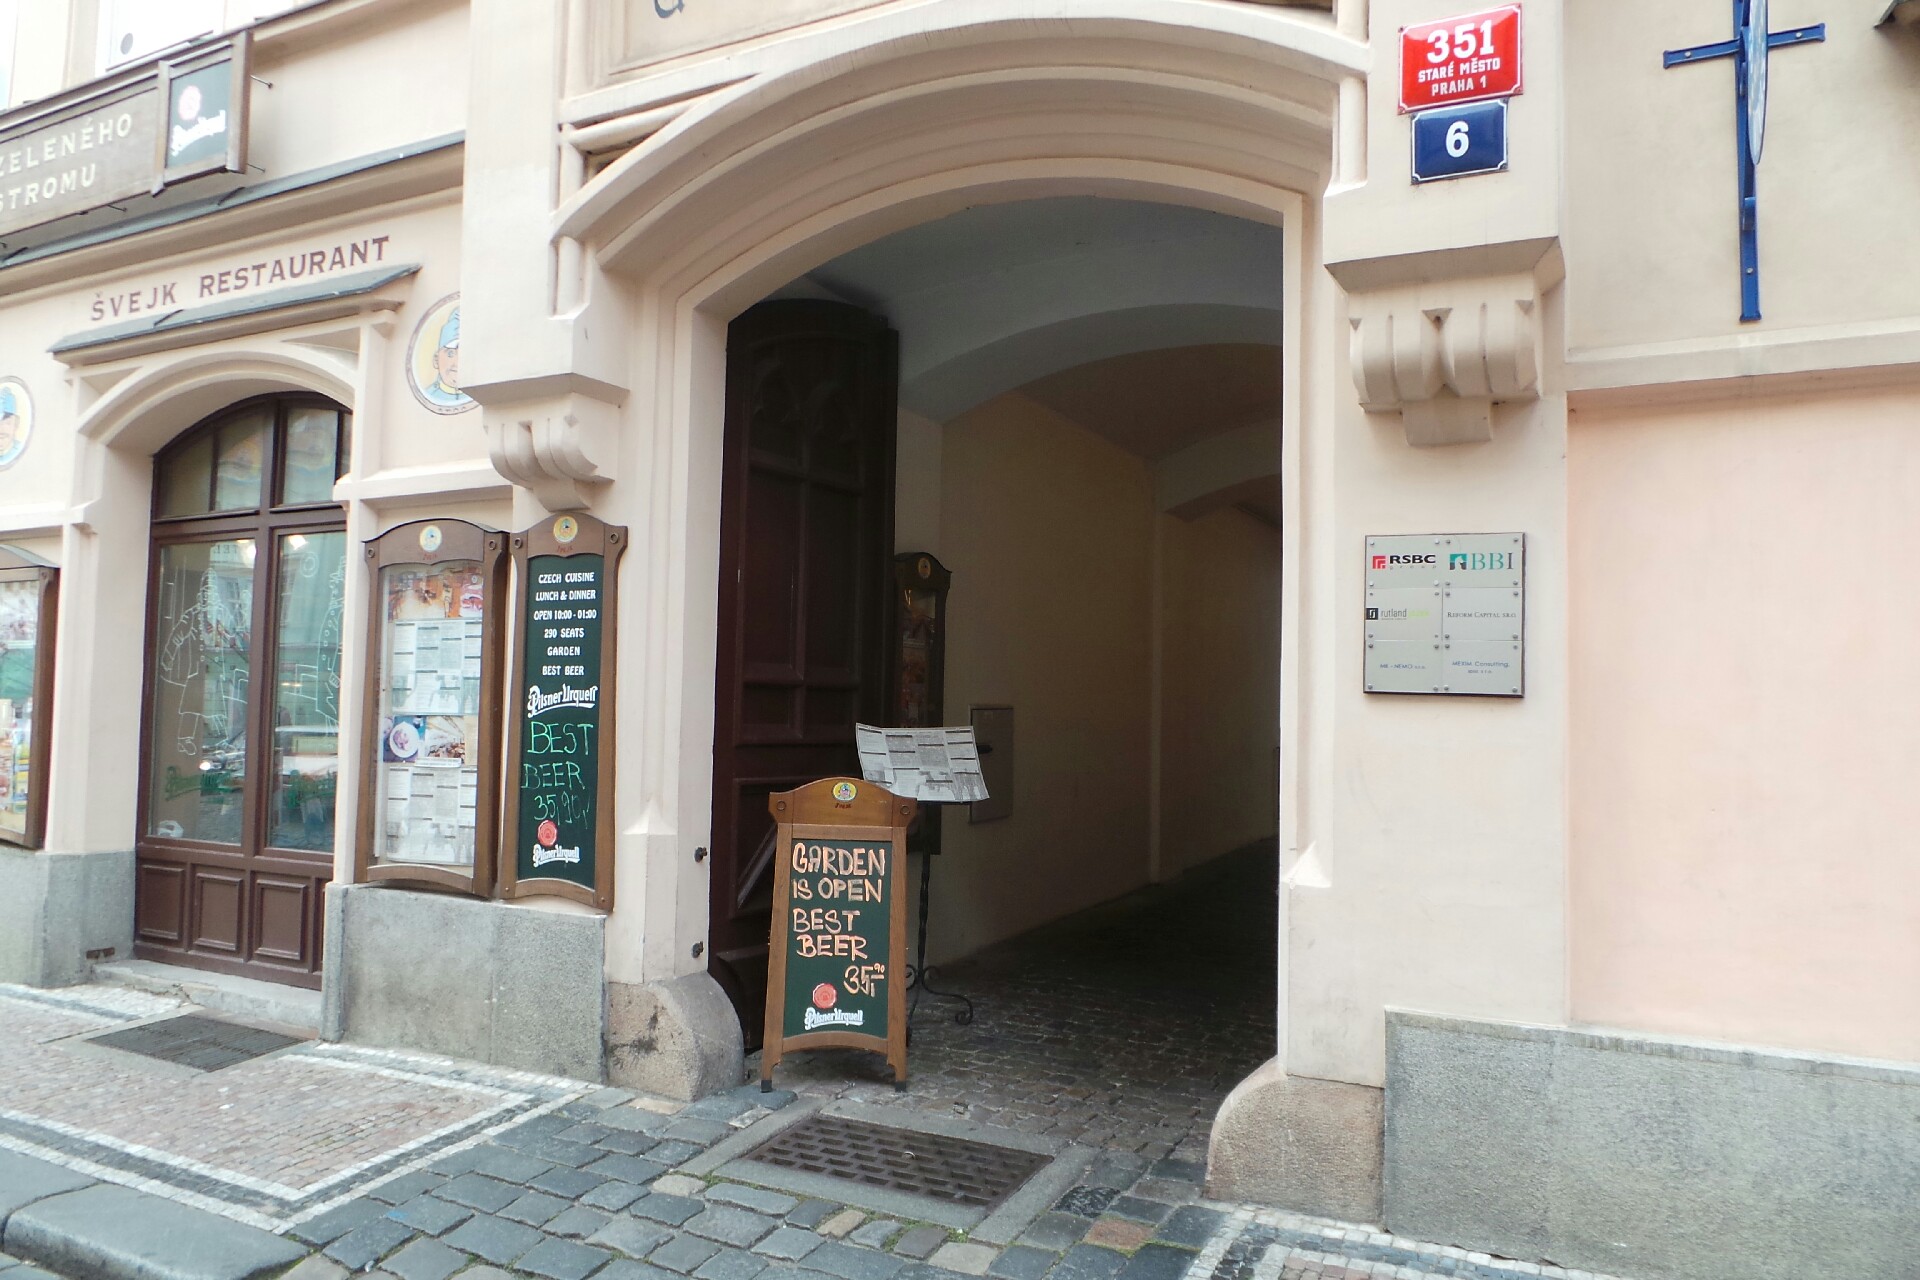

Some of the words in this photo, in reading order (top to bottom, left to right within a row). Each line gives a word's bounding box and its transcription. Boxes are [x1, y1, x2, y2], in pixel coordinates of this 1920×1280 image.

[1426, 20, 1495, 63] 351
[1418, 61, 1454, 83] STARÉ
[1460, 57, 1500, 76] MĚSTO
[1432, 78, 1474, 96] PRAHA
[1480, 75, 1487, 88] 1
[1446, 121, 1469, 157] 6
[91, 282, 177, 322] ŠVEJK
[199, 235, 390, 299] RESTAURANT
[1389, 554, 1436, 564] RSBC
[1471, 552, 1514, 571] BBI
[538, 573, 562, 584] CZECH
[565, 572, 595, 583] CUISINE
[535, 591, 559, 602] LUNCH
[560, 590, 568, 601] &
[569, 589, 596, 601] DINNER
[534, 610, 552, 621] OPEN
[554, 609, 573, 620] 10:00
[578, 609, 597, 620] 01:00
[1381, 608, 1407, 618] rutland
[544, 628, 557, 639] 290
[561, 627, 585, 638] SEATS
[547, 646, 581, 657] GARDEN
[542, 665, 562, 676] BEST
[564, 665, 585, 676] BEER
[527, 685, 563, 719] Pilsner
[562, 683, 599, 707] Urquell
[527, 721, 594, 756] BEST
[521, 761, 586, 790] BEER
[533, 843, 556, 868] Pilsner
[554, 843, 580, 863] Urquell
[792, 842, 886, 877] GARDEN
[791, 878, 813, 900] IS
[817, 876, 883, 904] OPEN
[792, 907, 861, 934] BEST
[796, 934, 868, 962] BEER
[804, 1006, 835, 1031] Pilsner
[833, 1007, 864, 1027] Urquell
